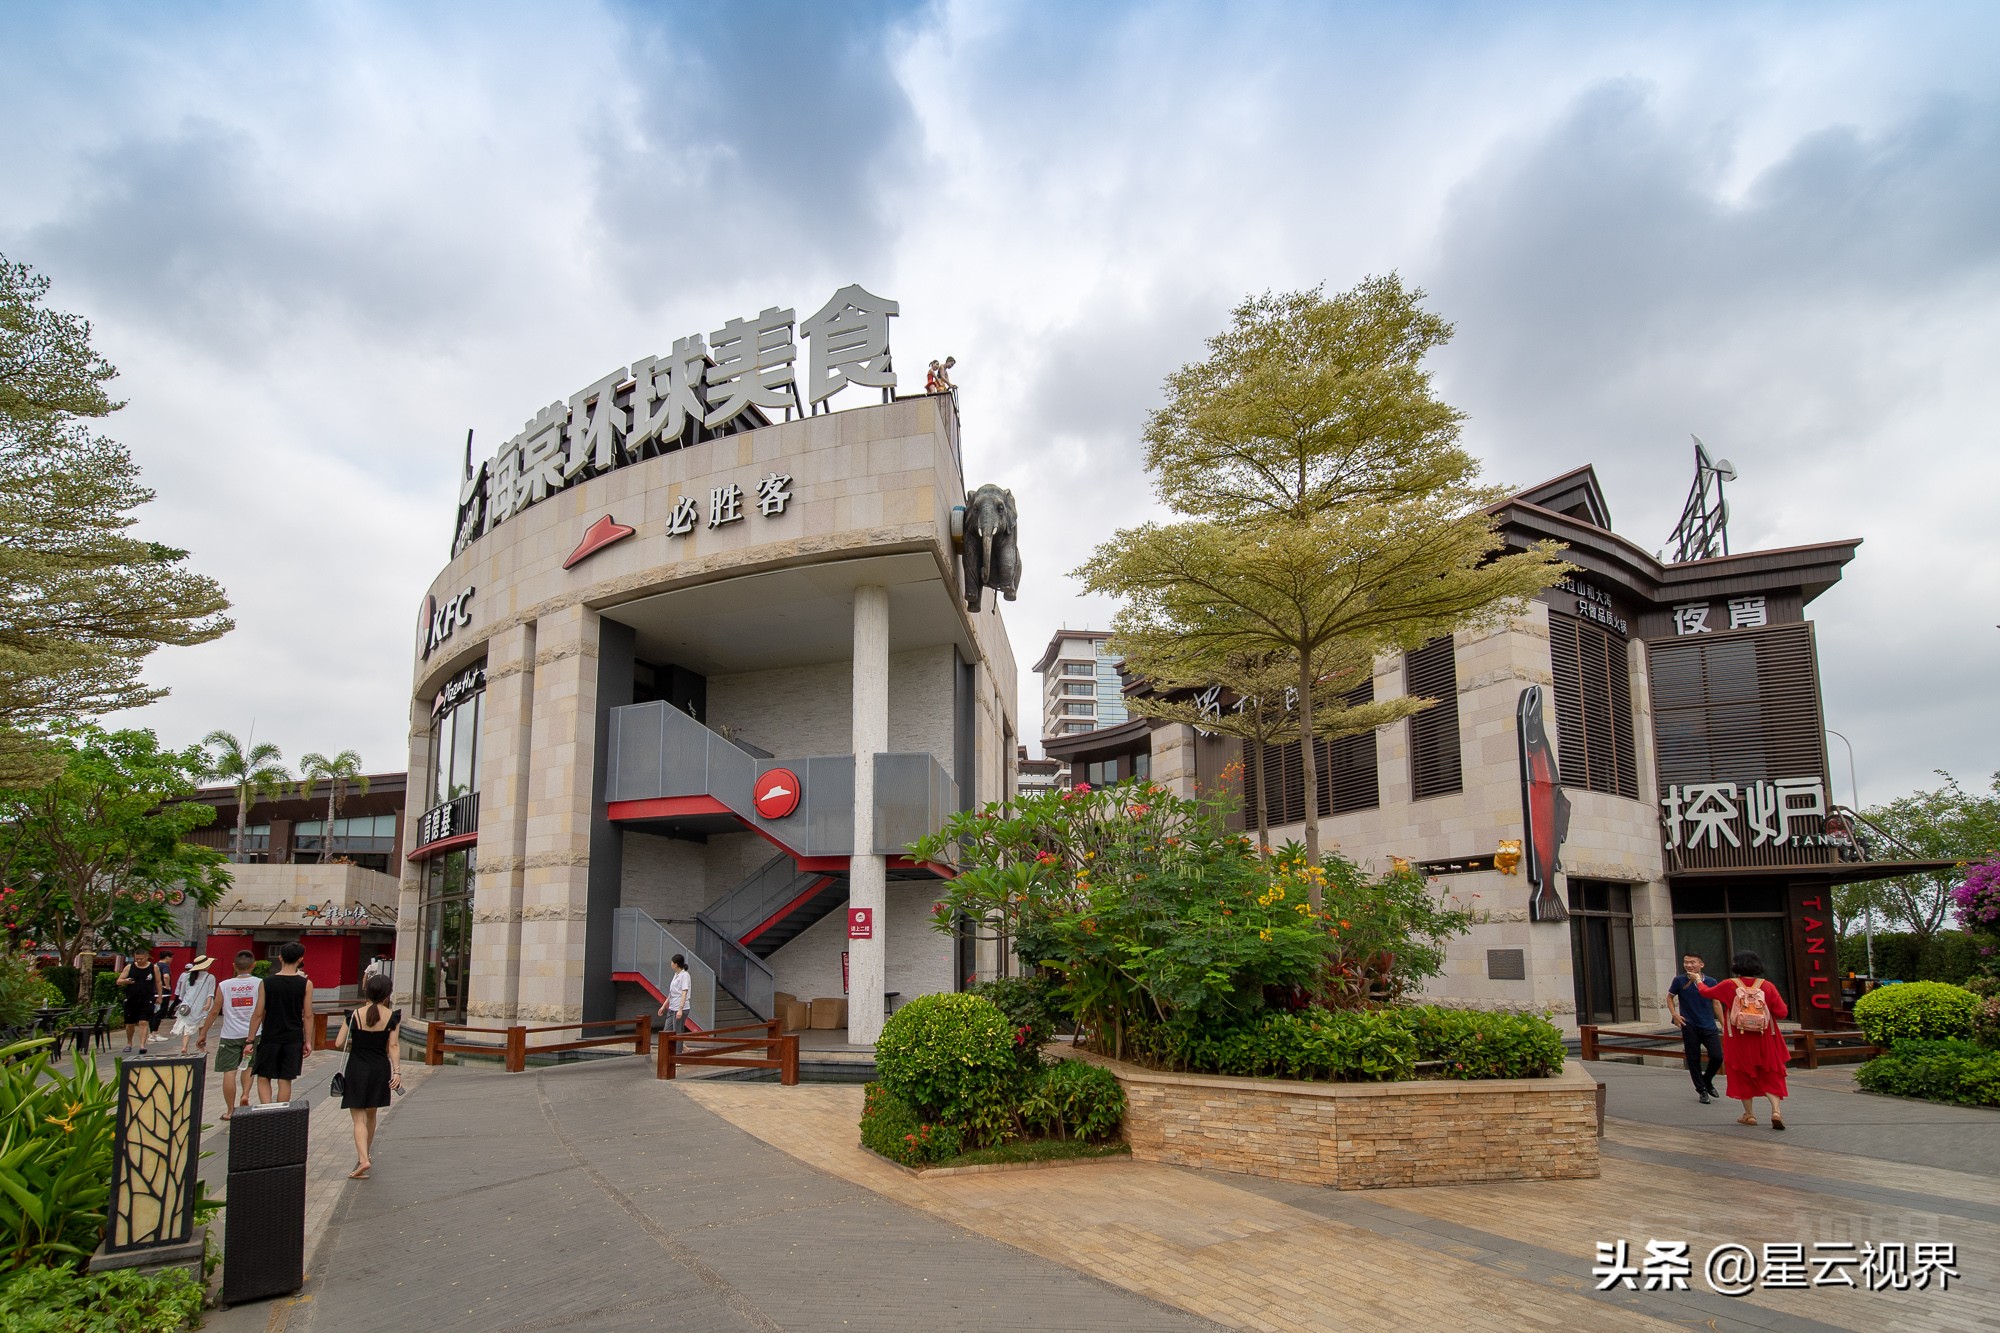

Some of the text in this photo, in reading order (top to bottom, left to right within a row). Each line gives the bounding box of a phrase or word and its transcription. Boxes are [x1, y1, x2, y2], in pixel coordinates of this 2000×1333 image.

[482, 283, 899, 535] 海棠环球美食
[665, 471, 792, 538] 必胜客
[429, 585, 476, 650] KFC
[1579, 599, 1628, 635] 只做品质火锅
[1673, 595, 1767, 636] 夜宵
[423, 802, 453, 845] 肯德基
[1661, 776, 1825, 850] 探炉
[1802, 896, 1831, 1010] TAN-LU
